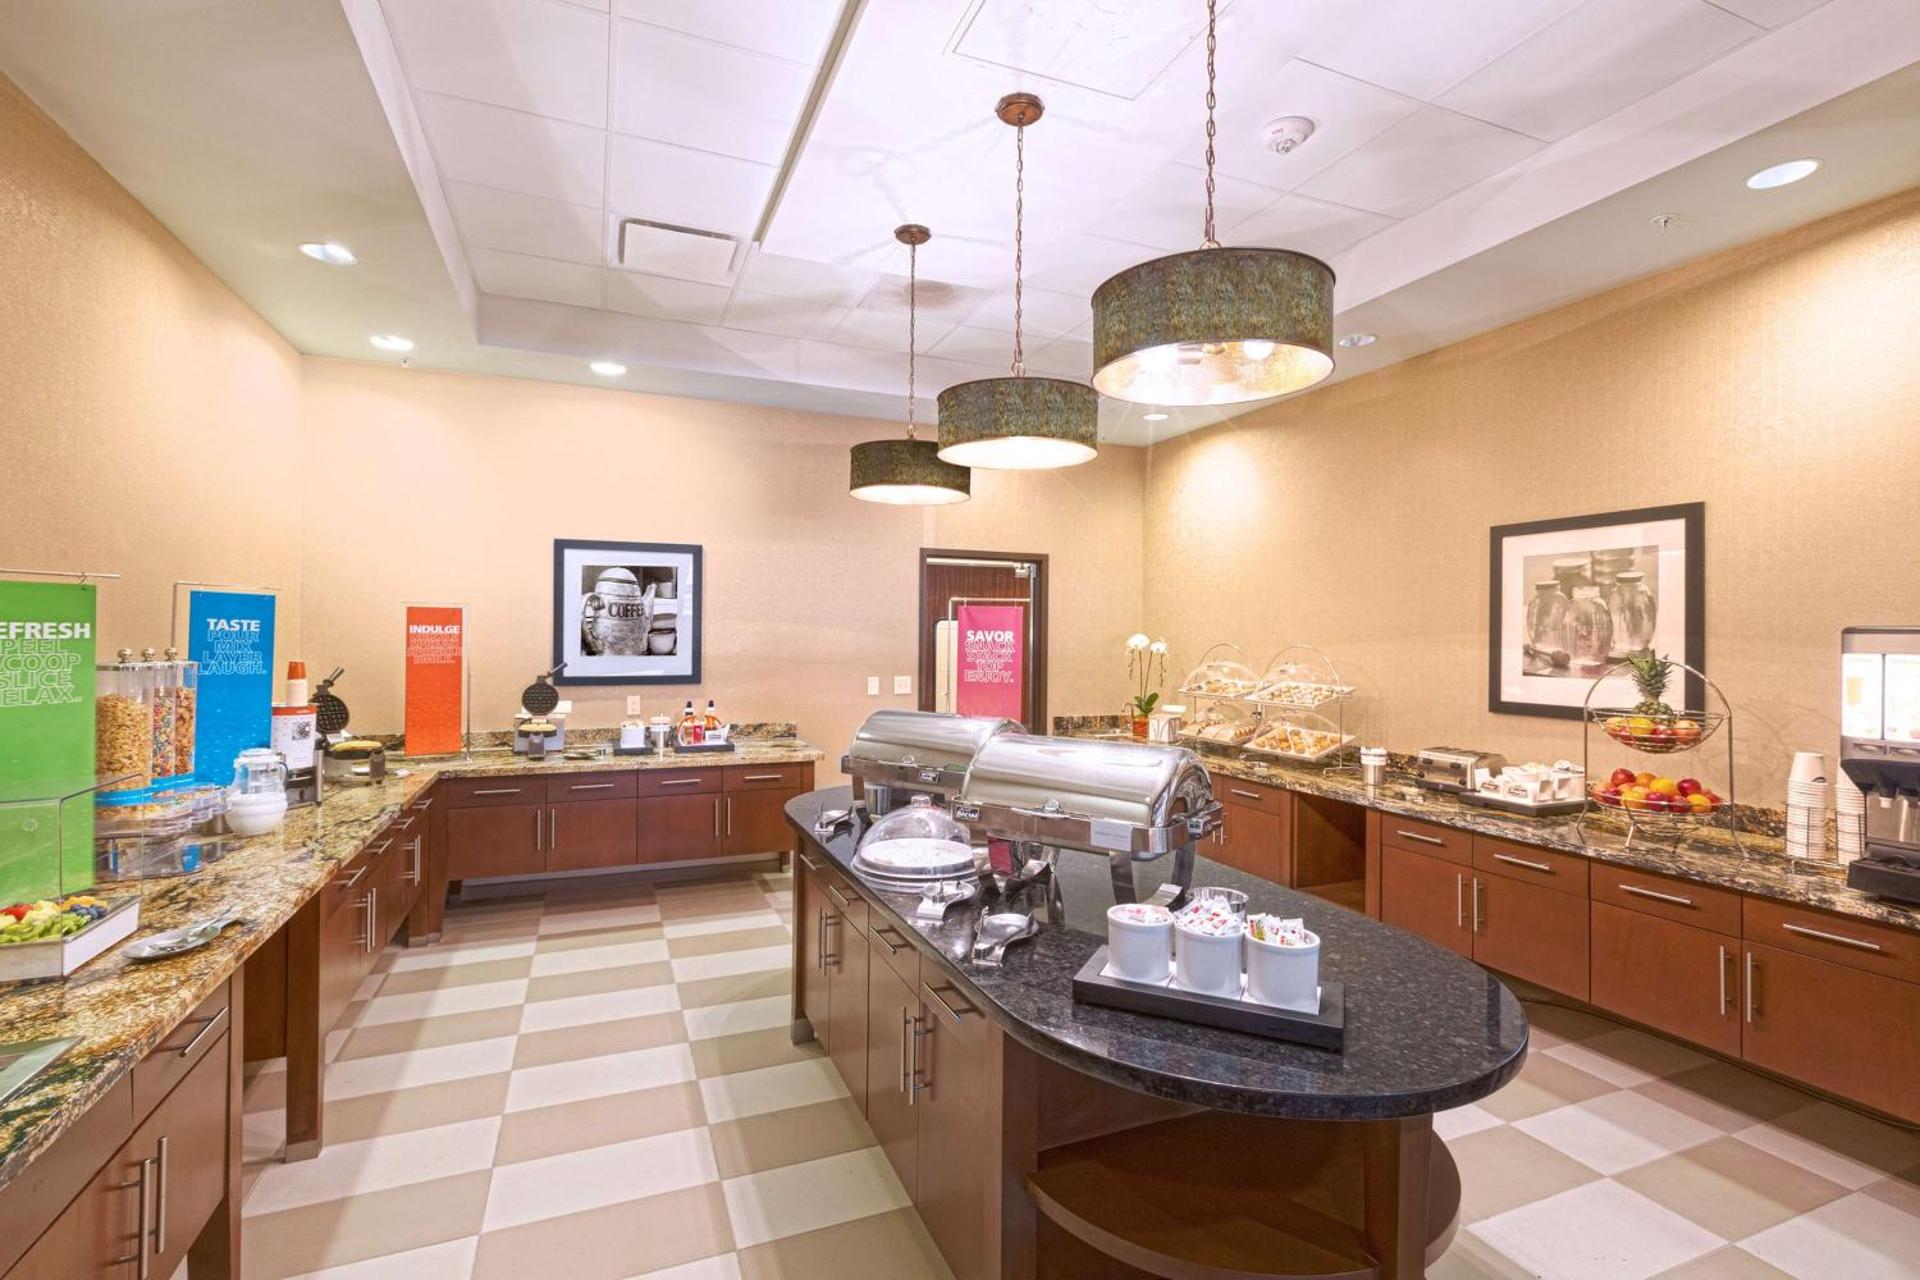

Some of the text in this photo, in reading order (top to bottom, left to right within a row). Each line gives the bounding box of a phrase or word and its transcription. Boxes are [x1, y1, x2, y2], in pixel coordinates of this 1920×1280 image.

[0, 621, 91, 640] EFRESH
[206, 618, 261, 632] TASTE
[409, 624, 460, 635] INDULGE
[966, 630, 1014, 642] SAVOR
[1, 638, 68, 655] PEEL
[214, 640, 253, 654] MIX
[0, 652, 81, 673] COOP
[202, 650, 263, 664] LAYER
[0, 685, 83, 707] ELAX.
